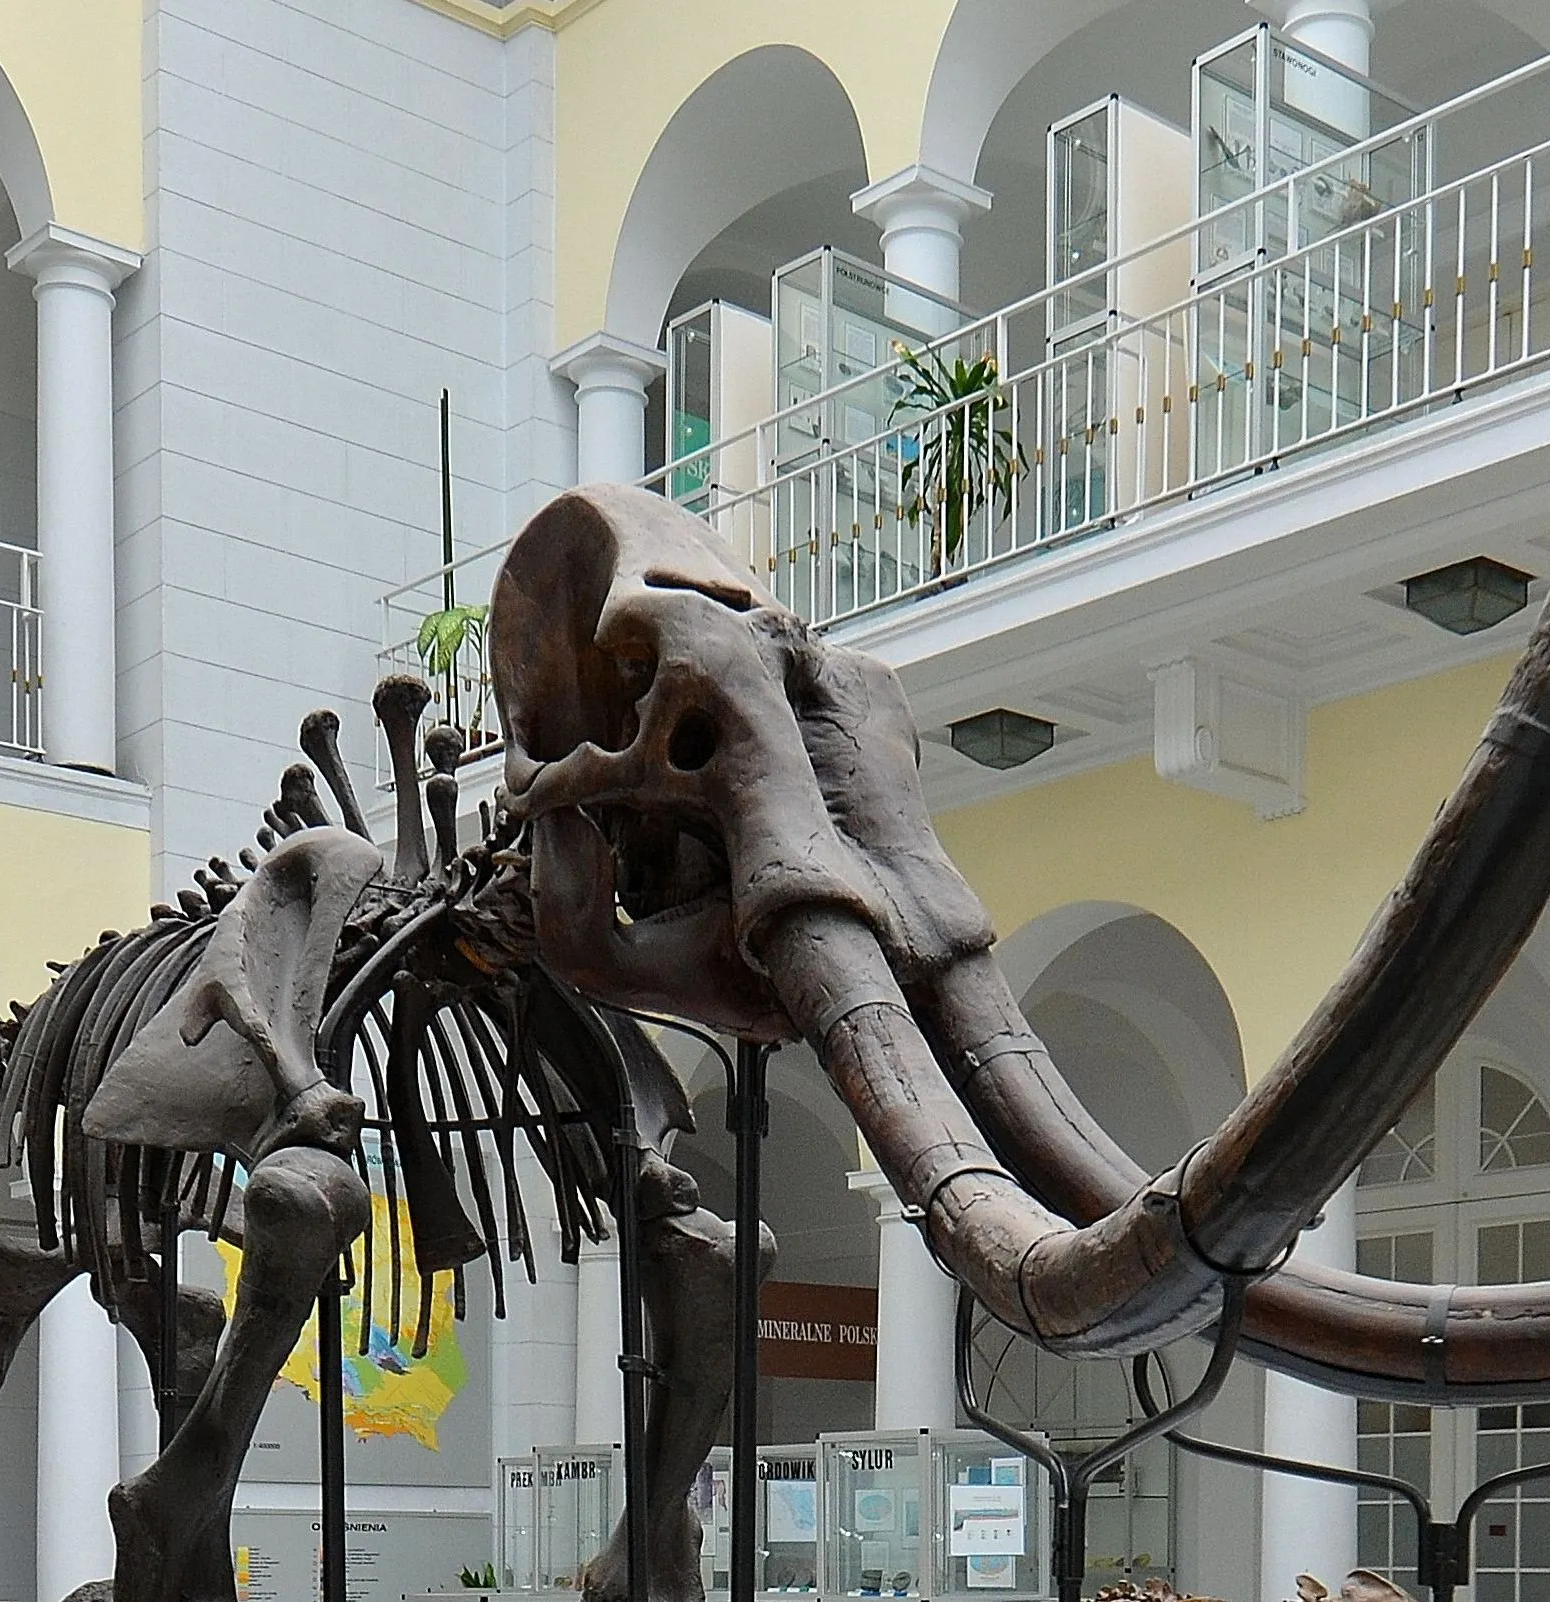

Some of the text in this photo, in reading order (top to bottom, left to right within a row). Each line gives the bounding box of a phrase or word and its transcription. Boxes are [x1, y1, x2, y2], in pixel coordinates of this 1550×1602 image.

[757, 1319, 832, 1343] MINERALNE
[556, 1461, 596, 1480] KAMBR
[758, 1460, 816, 1481] ORDOWIK
[851, 1449, 893, 1471] SYLUR
[510, 1471, 562, 1488] PREKMBR
